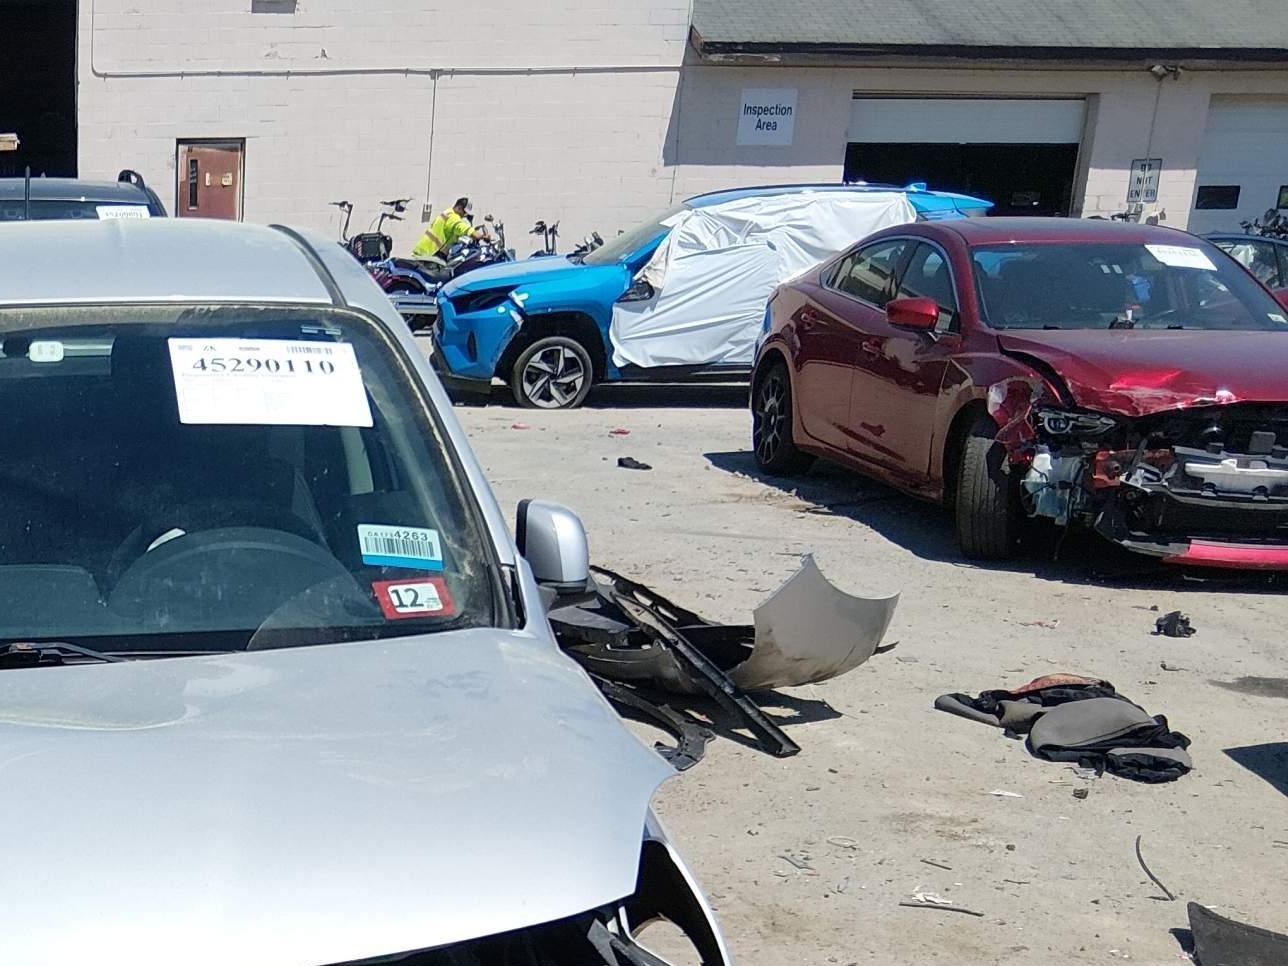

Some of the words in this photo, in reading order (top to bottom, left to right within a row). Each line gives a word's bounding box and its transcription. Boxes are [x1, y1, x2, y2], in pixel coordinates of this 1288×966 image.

[743, 103, 793, 118] Inspection
[755, 118, 777, 131] Area
[1130, 189, 1155, 198] ENER
[192, 357, 335, 375] 45290110
[391, 588, 424, 608] 12
